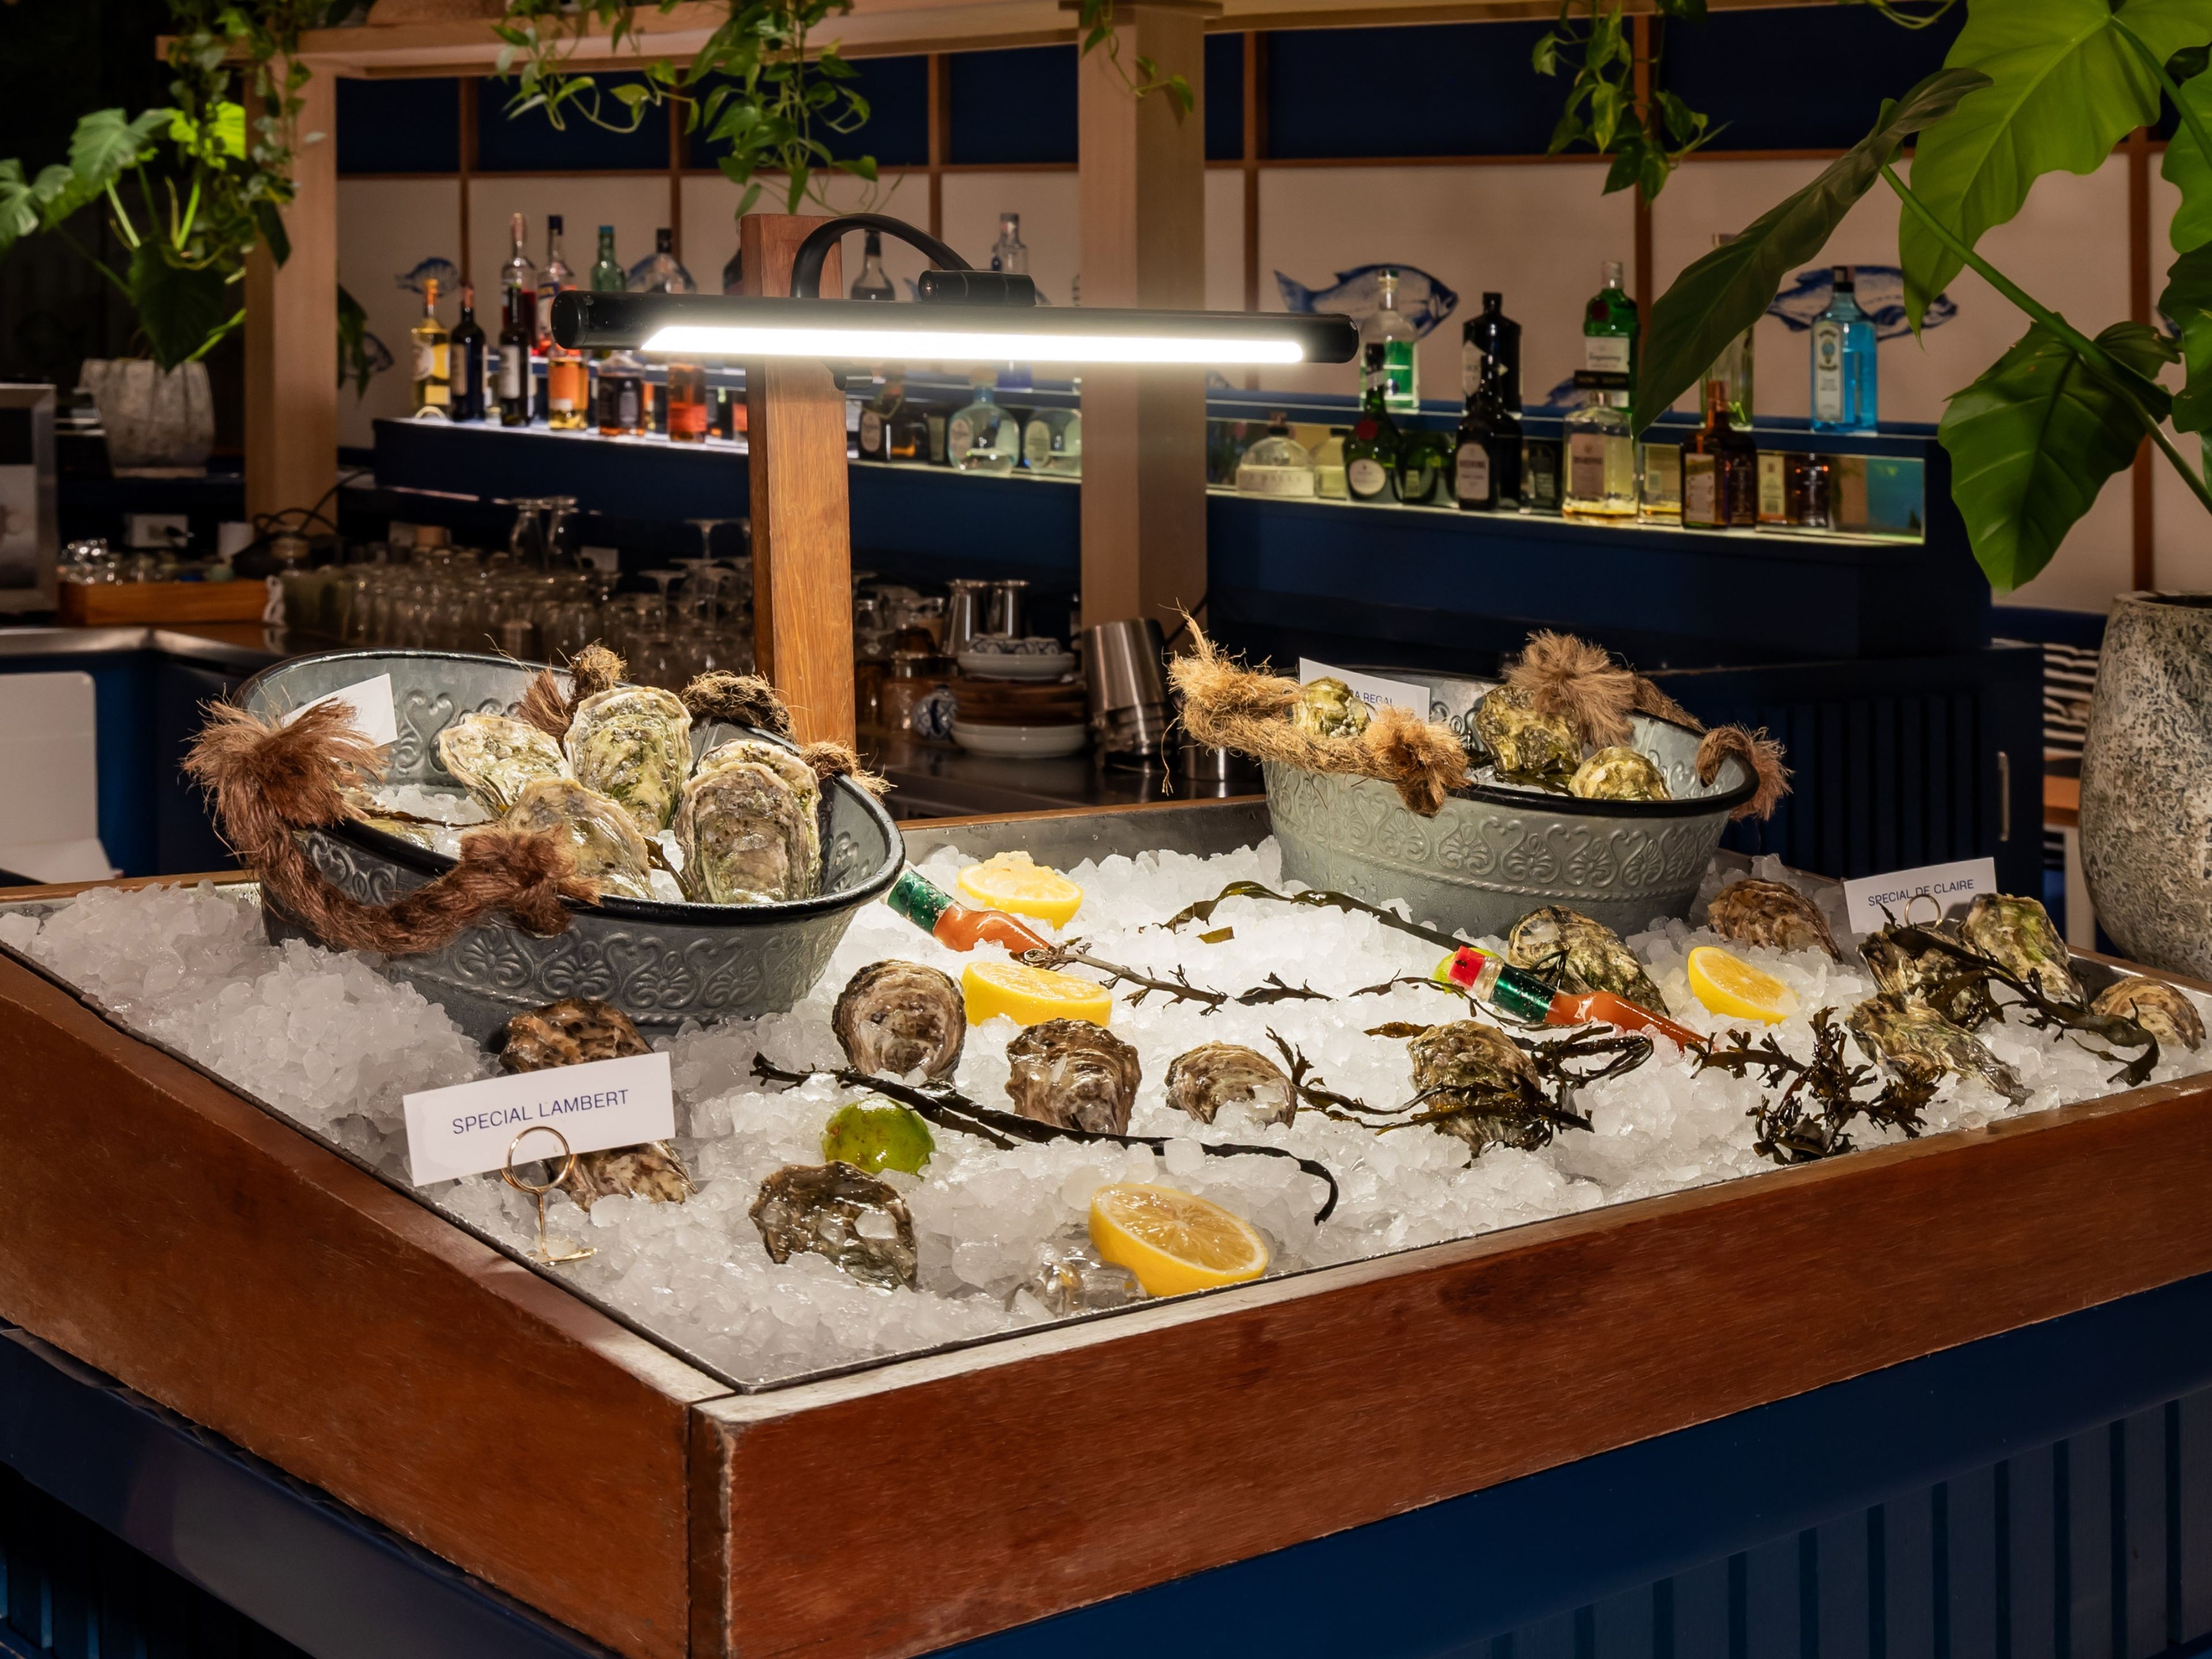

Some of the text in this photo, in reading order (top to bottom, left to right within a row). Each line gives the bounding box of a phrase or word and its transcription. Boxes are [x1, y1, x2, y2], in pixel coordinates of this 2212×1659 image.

[1868, 879, 1974, 906] SPECIAL DE CLAIRE
[452, 1089, 629, 1135] SPECIAL LAMBERT
